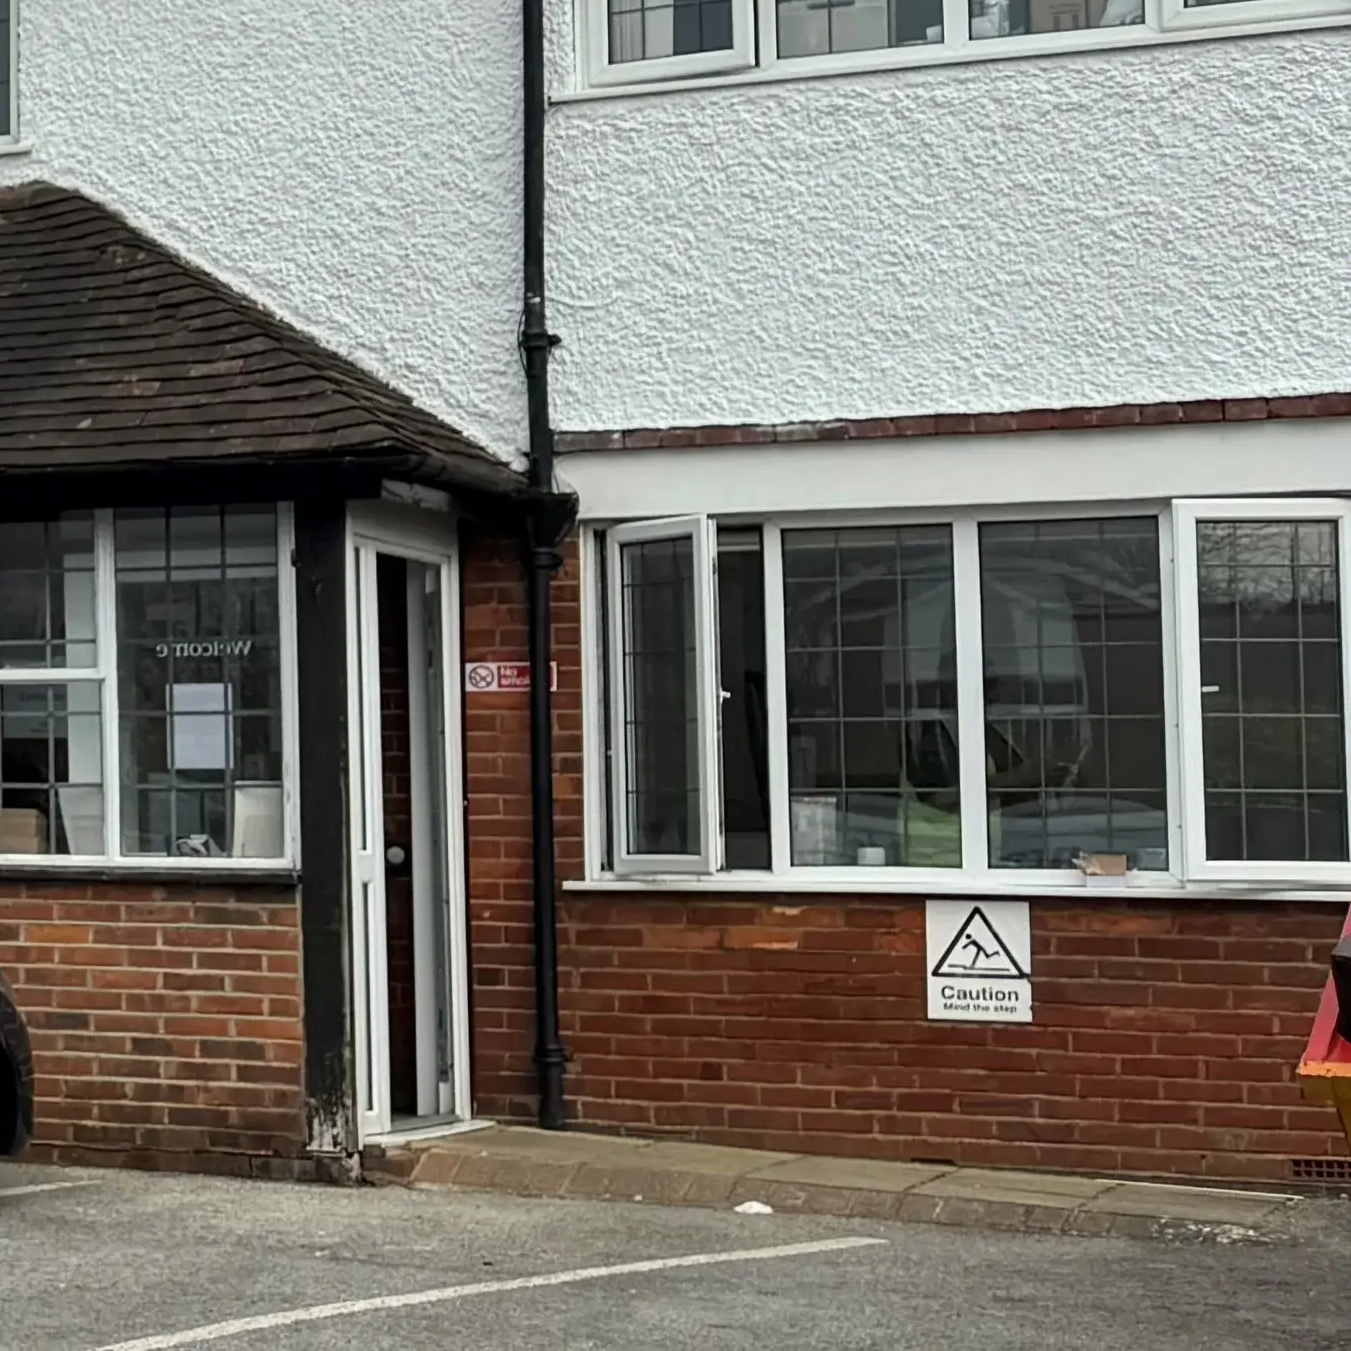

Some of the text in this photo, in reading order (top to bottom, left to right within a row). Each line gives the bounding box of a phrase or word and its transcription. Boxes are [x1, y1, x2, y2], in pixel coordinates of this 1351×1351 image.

[941, 984, 1019, 1001] Caution
[943, 1002, 1017, 1014] Mind the step
